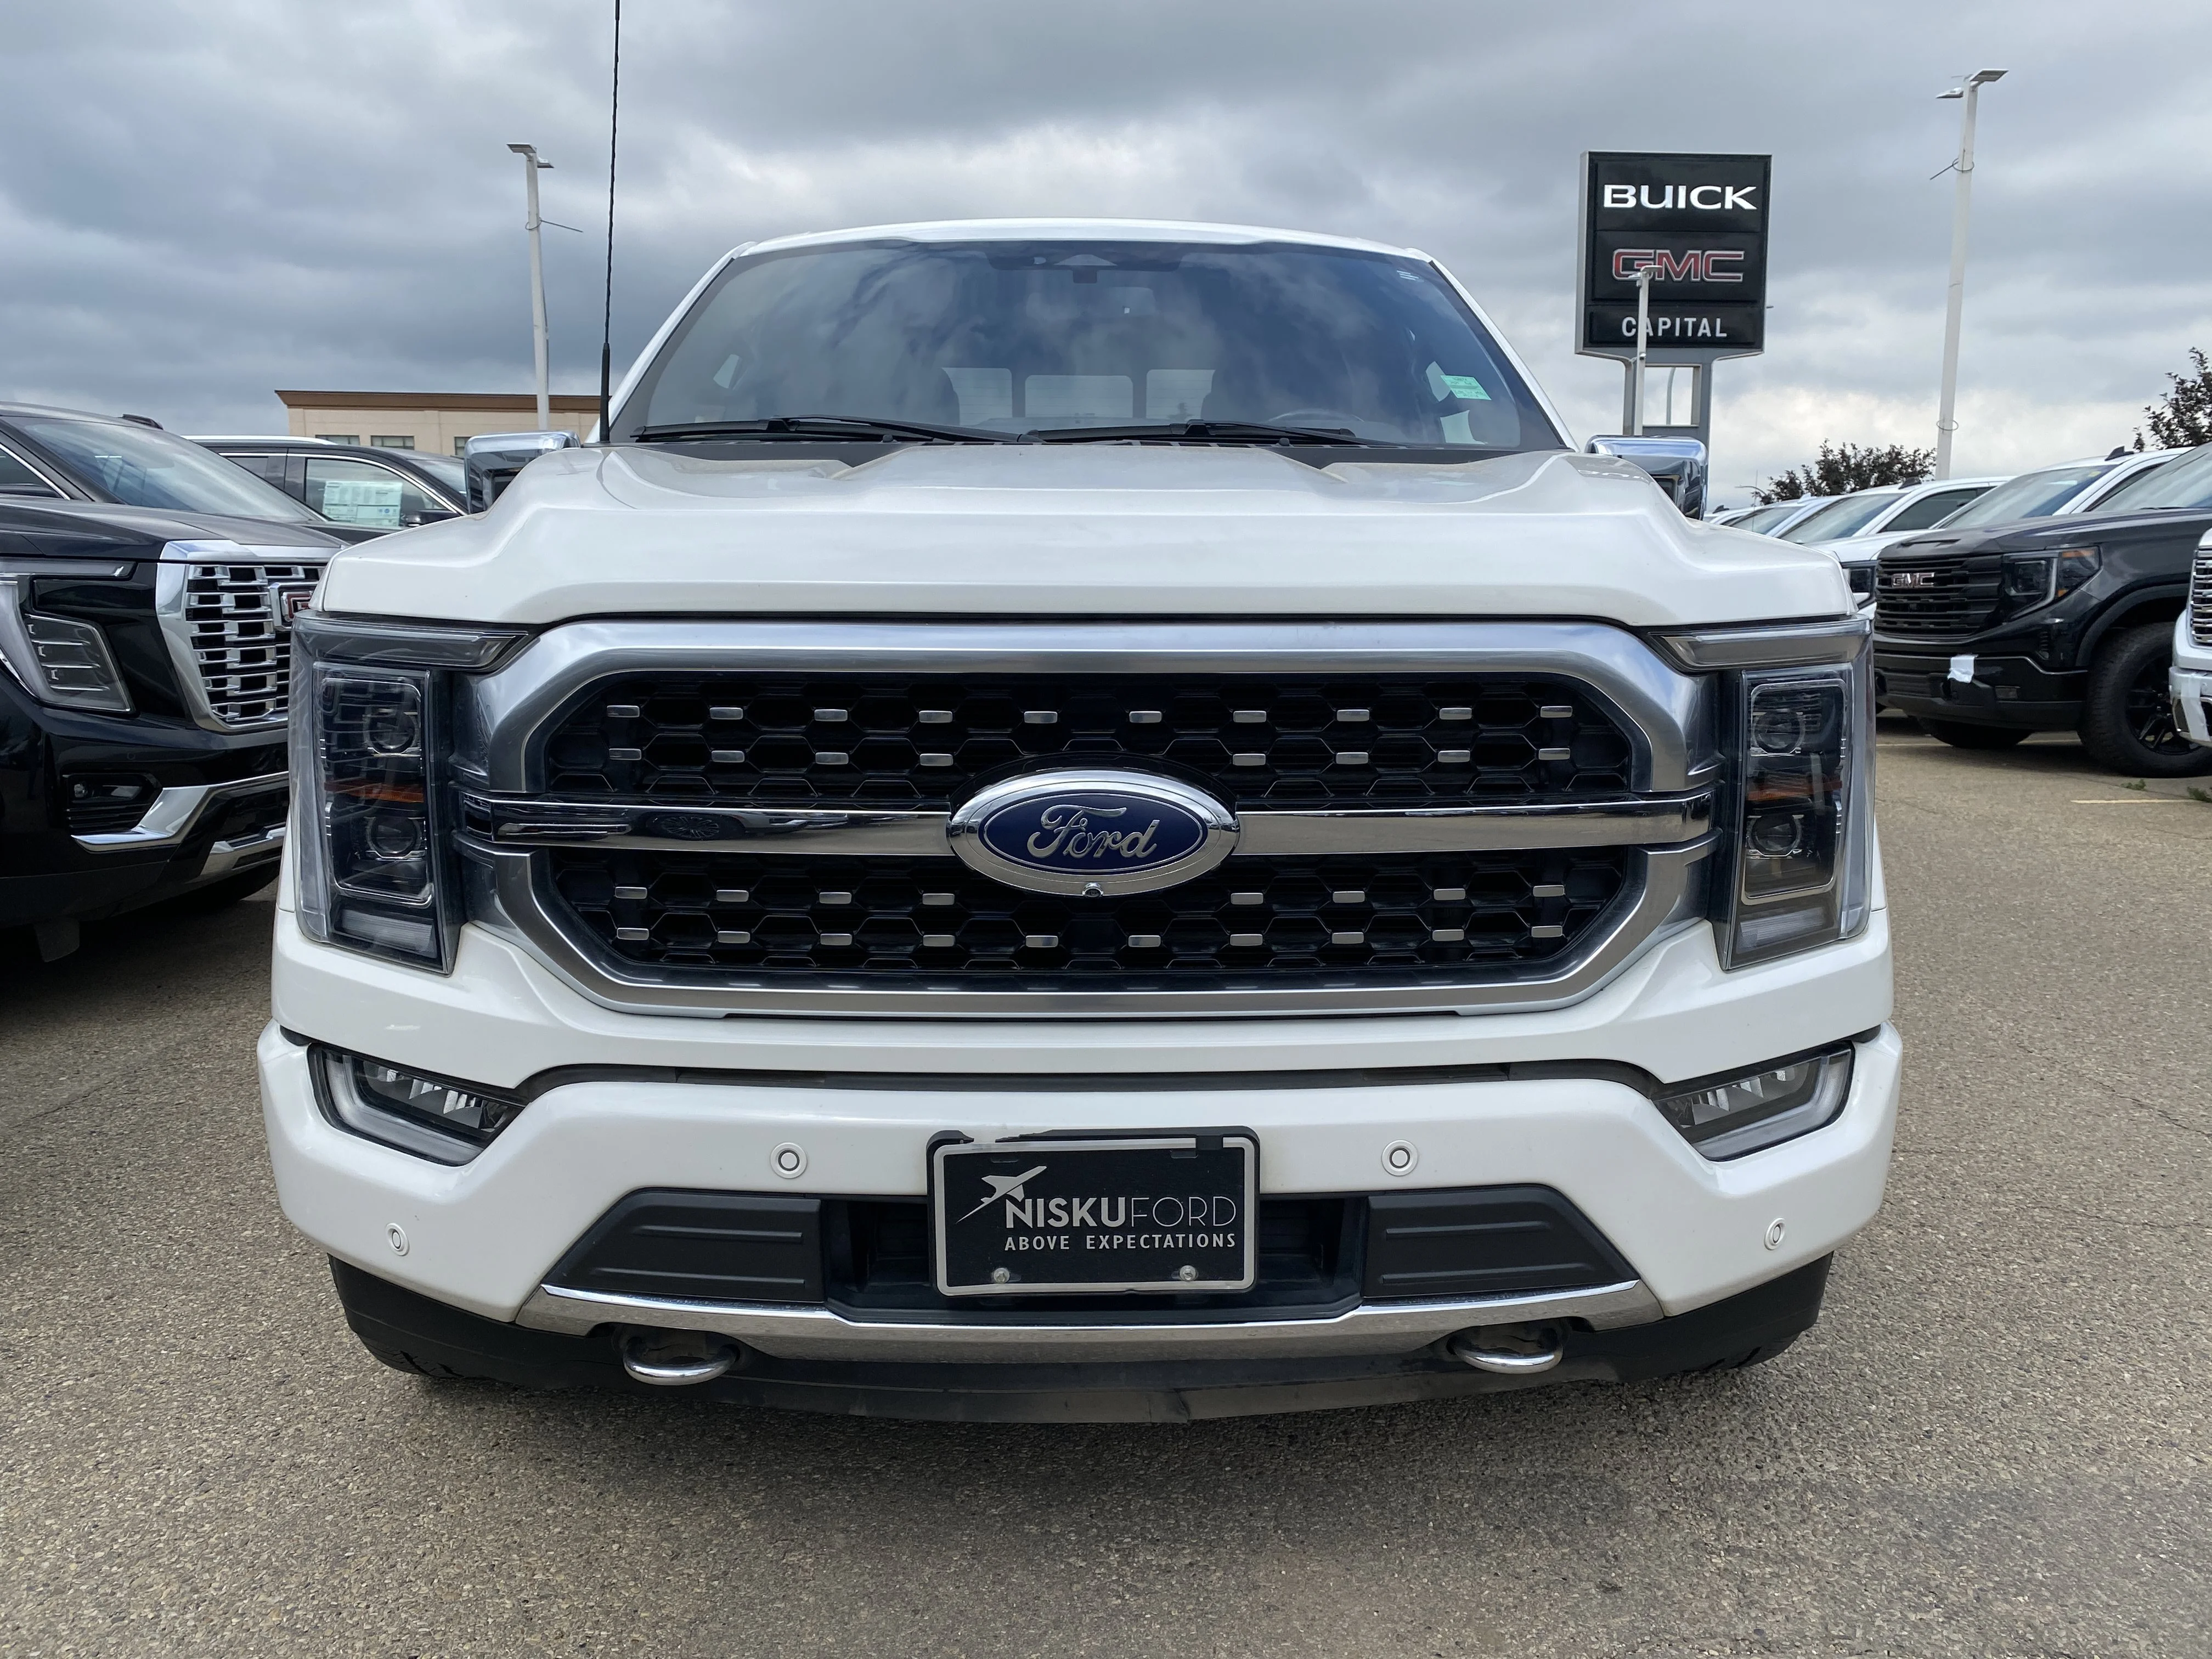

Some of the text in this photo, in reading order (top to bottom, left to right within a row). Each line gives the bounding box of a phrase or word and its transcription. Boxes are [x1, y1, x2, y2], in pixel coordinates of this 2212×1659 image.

[1603, 185, 1757, 210] BUICK
[1613, 249, 1745, 283] GMC
[1893, 572, 1935, 588] GMC
[1027, 804, 1160, 859] Ford
[1005, 1233, 1235, 1251] ABOVE EXPECTATIONS
